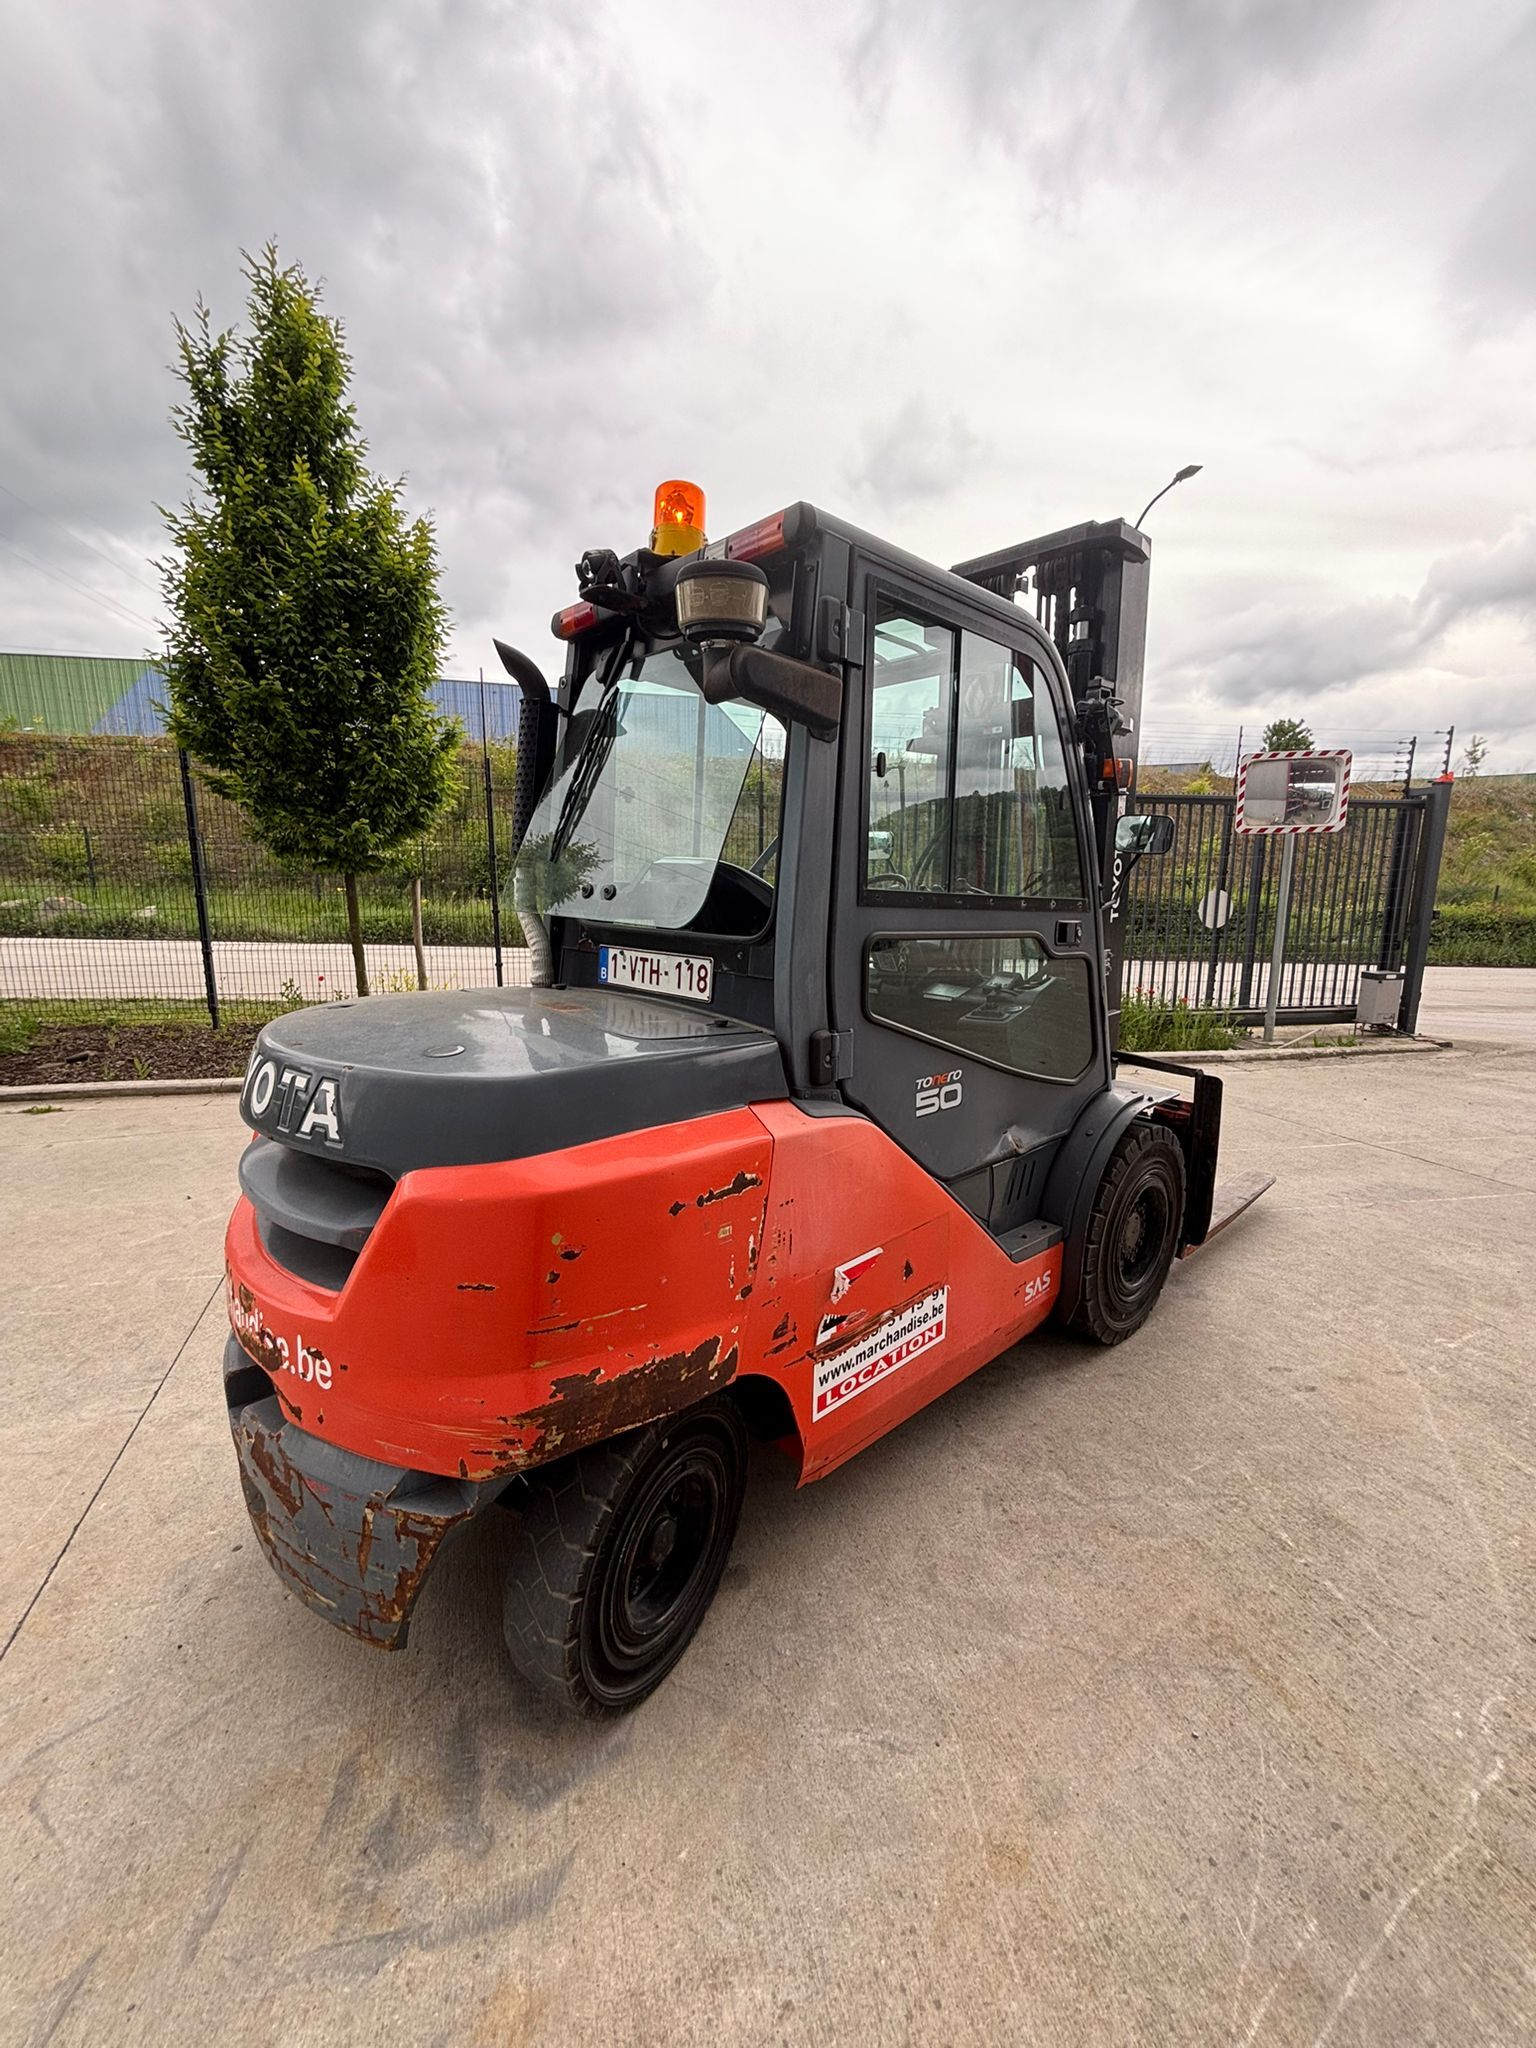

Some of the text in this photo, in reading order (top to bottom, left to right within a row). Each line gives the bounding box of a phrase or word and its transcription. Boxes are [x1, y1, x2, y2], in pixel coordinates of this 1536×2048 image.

[601, 967, 607, 979] B
[916, 1082, 963, 1117] 50
[1025, 1270, 1051, 1302] SAS
[818, 1302, 944, 1387] www.marchandise.be
[825, 1326, 937, 1406] LOCATION
